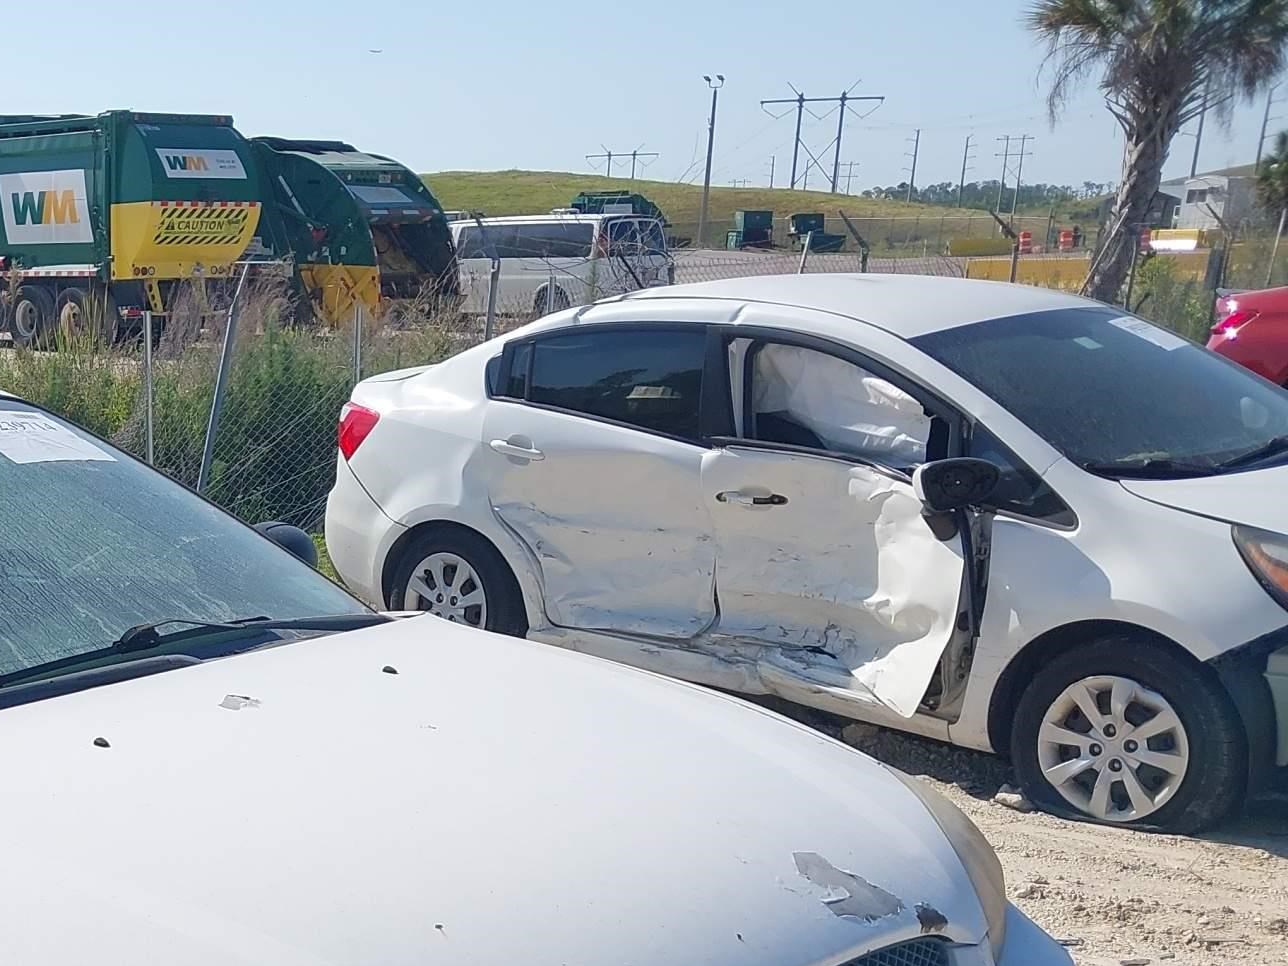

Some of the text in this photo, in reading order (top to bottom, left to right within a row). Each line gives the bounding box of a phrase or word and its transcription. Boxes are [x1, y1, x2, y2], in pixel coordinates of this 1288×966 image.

[165, 155, 209, 171] WM
[11, 189, 80, 226] WM
[177, 220, 225, 231] CAUTION
